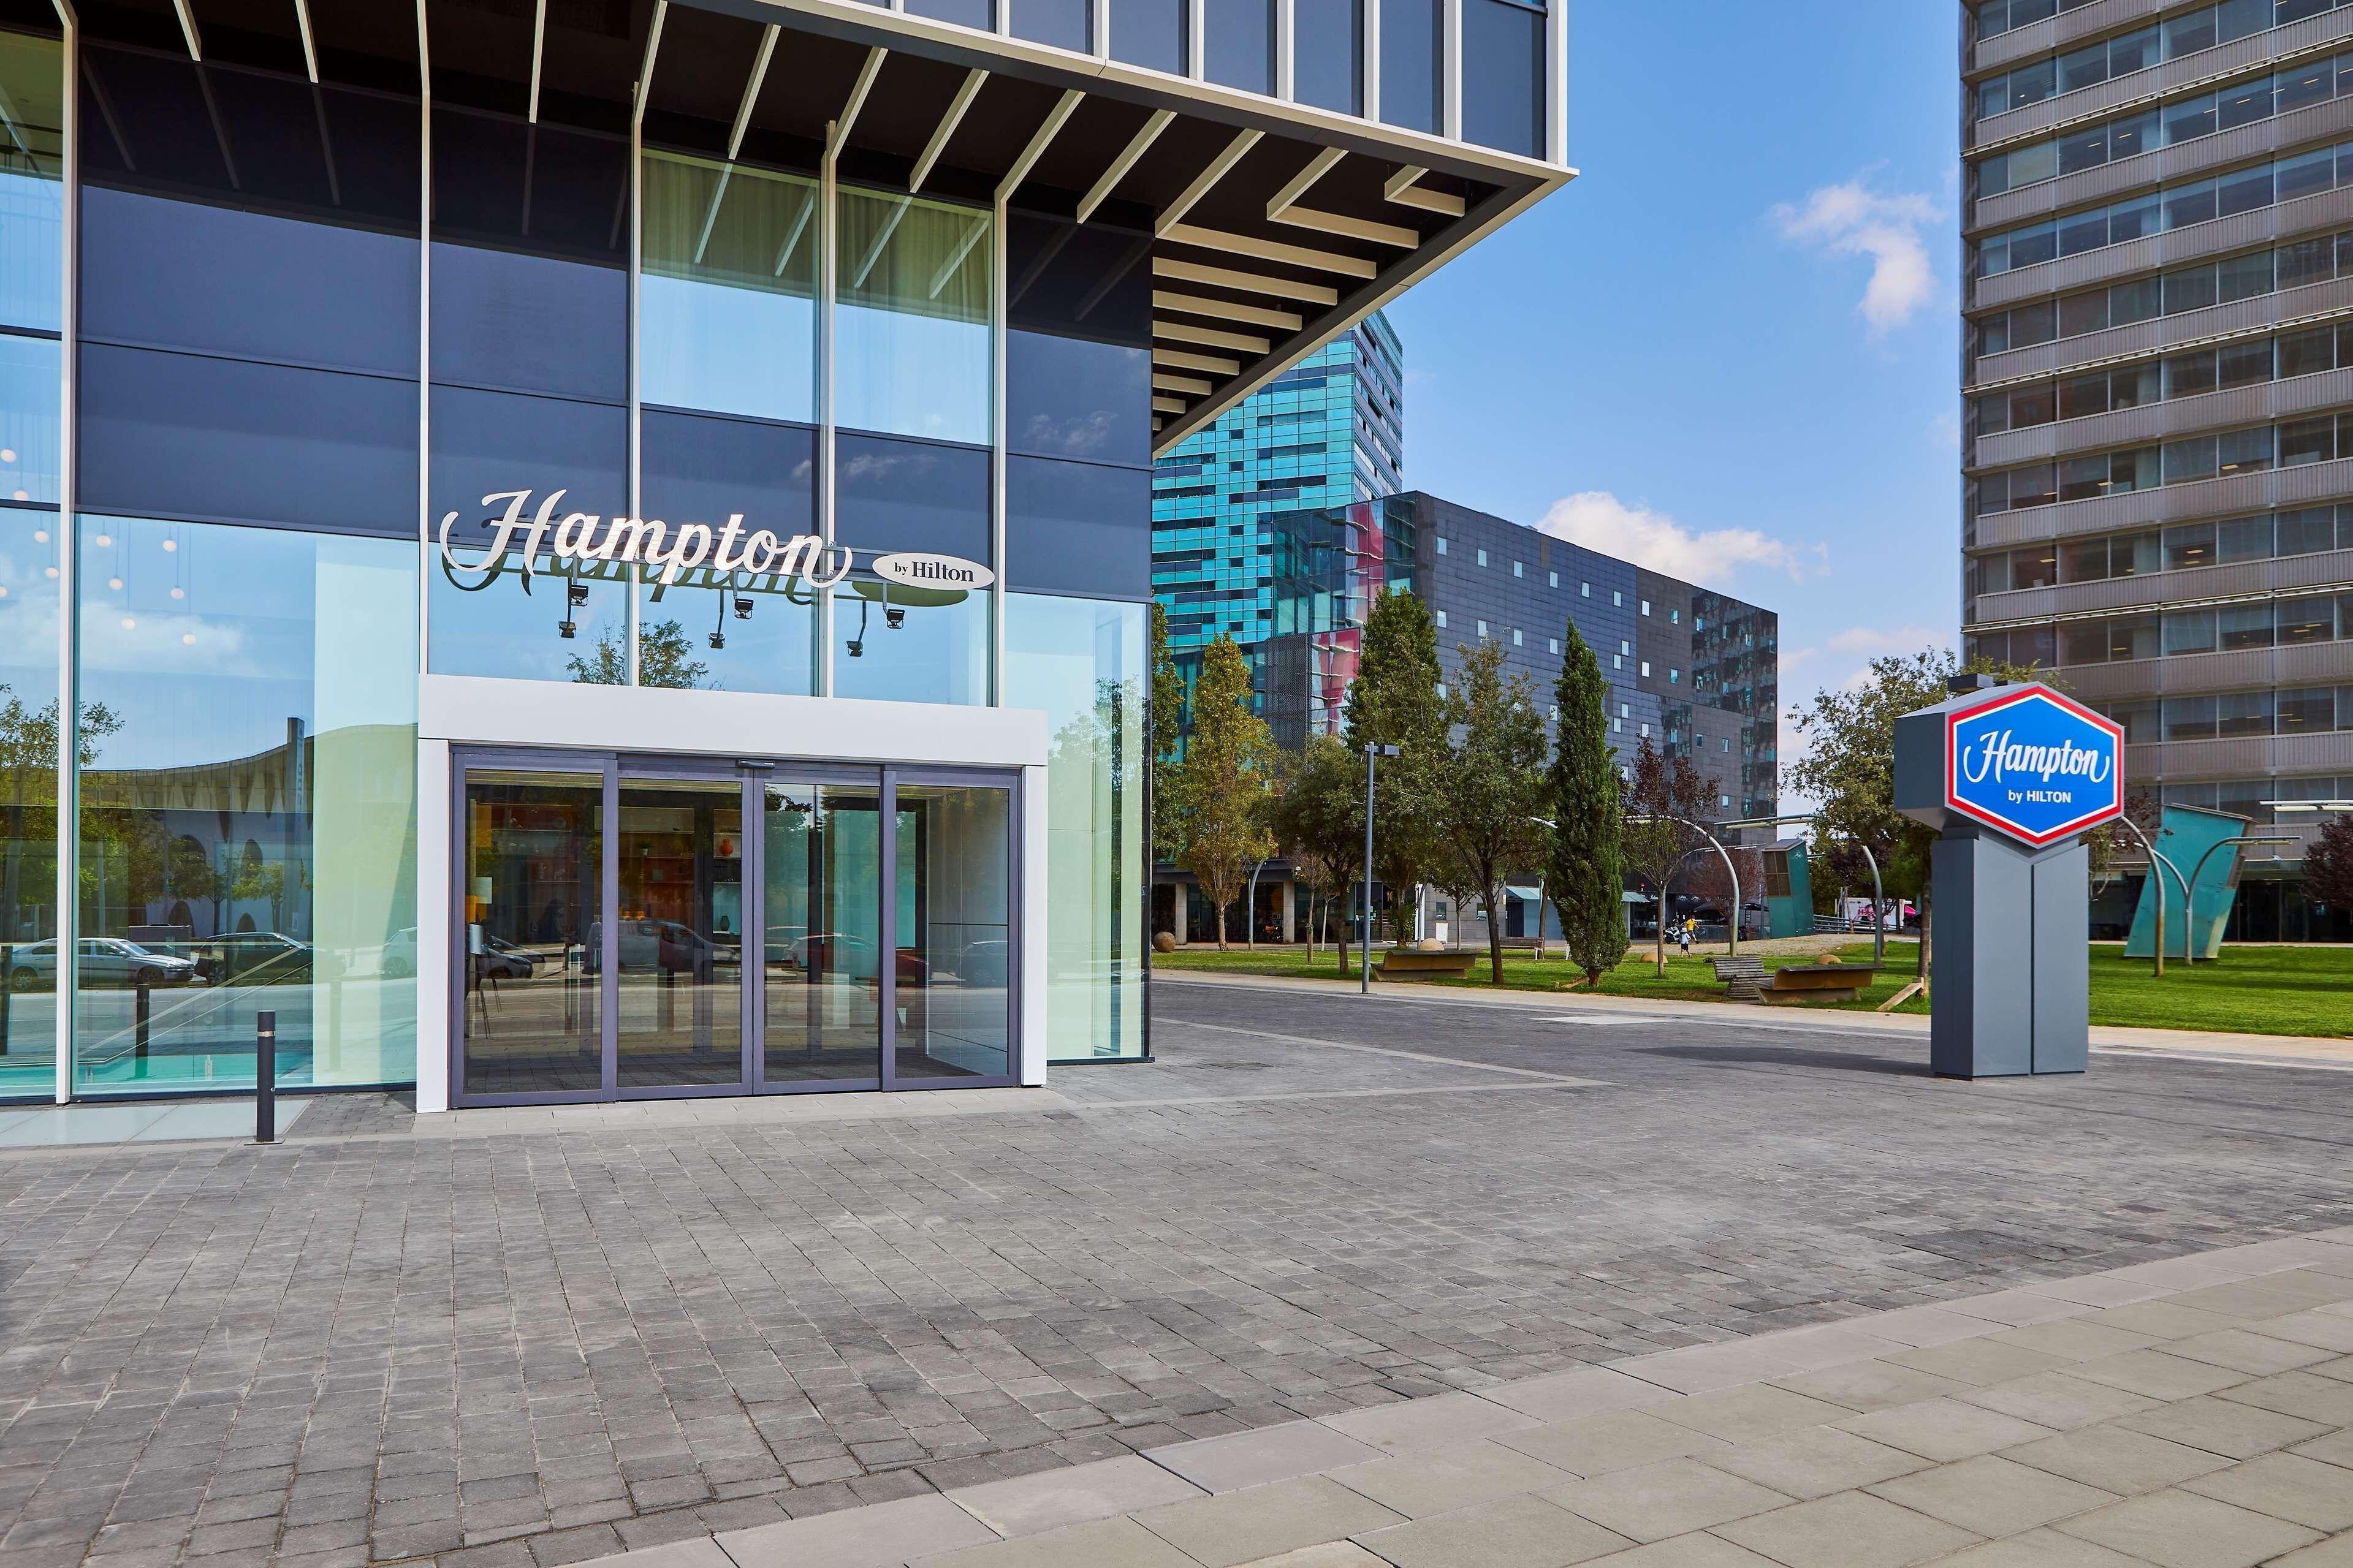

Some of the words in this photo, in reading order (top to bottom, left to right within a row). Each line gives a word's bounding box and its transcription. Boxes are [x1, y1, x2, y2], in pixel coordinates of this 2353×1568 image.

[439, 489, 852, 588] Hampton
[894, 562, 908, 575] by
[911, 561, 975, 581] Hilton
[1963, 730, 2110, 784] Hampton
[2008, 789, 2023, 804] by
[2026, 790, 2072, 803] HILTON
